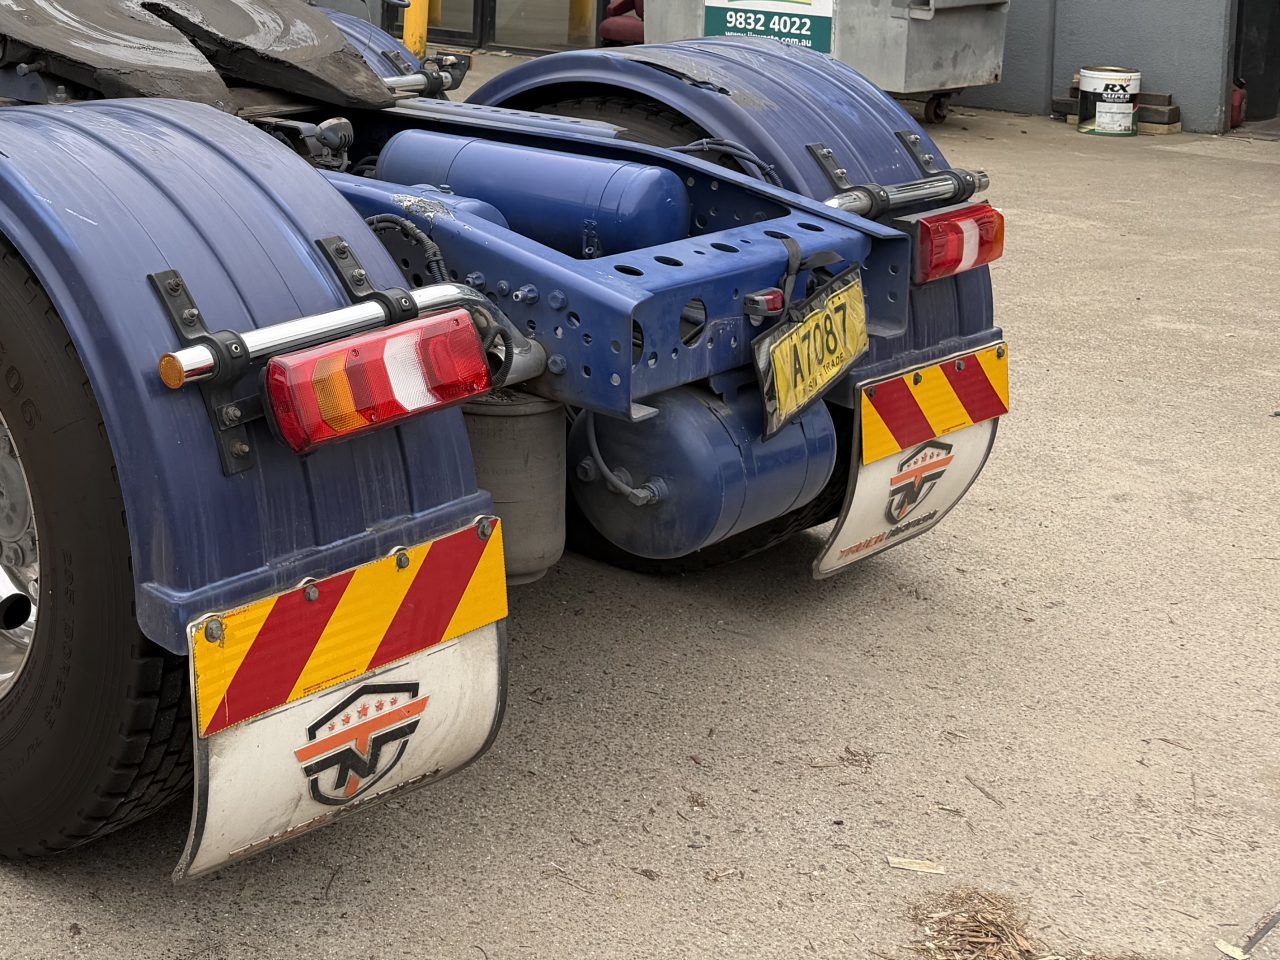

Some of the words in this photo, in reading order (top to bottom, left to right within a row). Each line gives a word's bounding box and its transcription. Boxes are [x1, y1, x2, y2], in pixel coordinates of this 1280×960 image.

[726, 11, 765, 31] 9832
[769, 16, 811, 35] 4022
[1103, 83, 1130, 93] RX
[791, 302, 847, 389] A7087
[822, 353, 845, 375] TRADE
